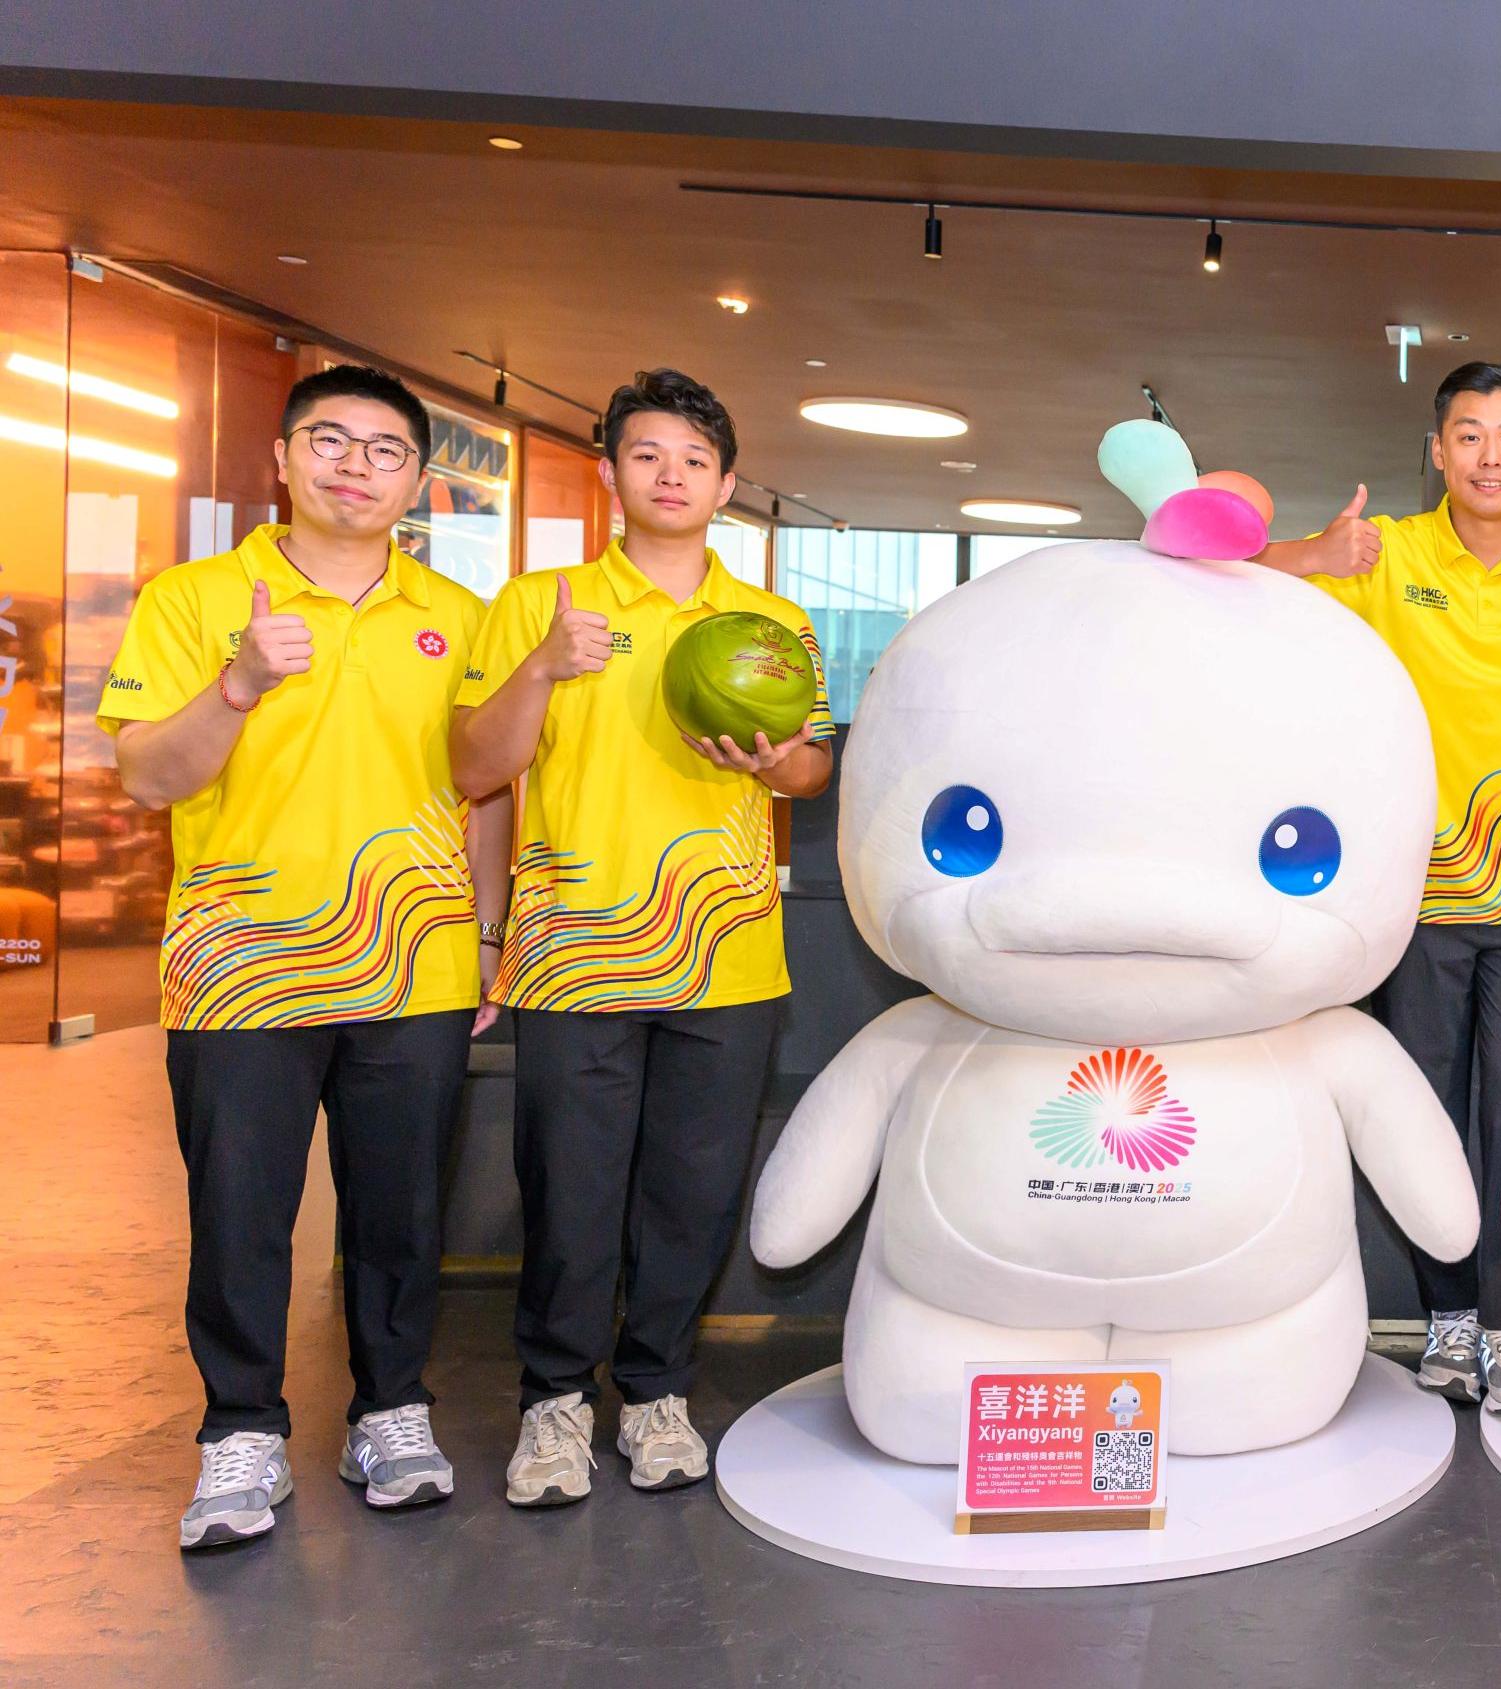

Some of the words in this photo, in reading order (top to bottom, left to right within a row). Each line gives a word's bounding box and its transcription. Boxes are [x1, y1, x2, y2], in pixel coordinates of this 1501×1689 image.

[612, 632, 632, 643] GX
[1157, 1182, 1193, 1194] 2025
[1110, 1194, 1132, 1204] Hong
[1134, 1195, 1157, 1204] Kong
[1162, 1194, 1191, 1202] Macao
[977, 1383, 1086, 1420] 喜洋洋
[978, 1424, 1083, 1444] Xiyangyang
